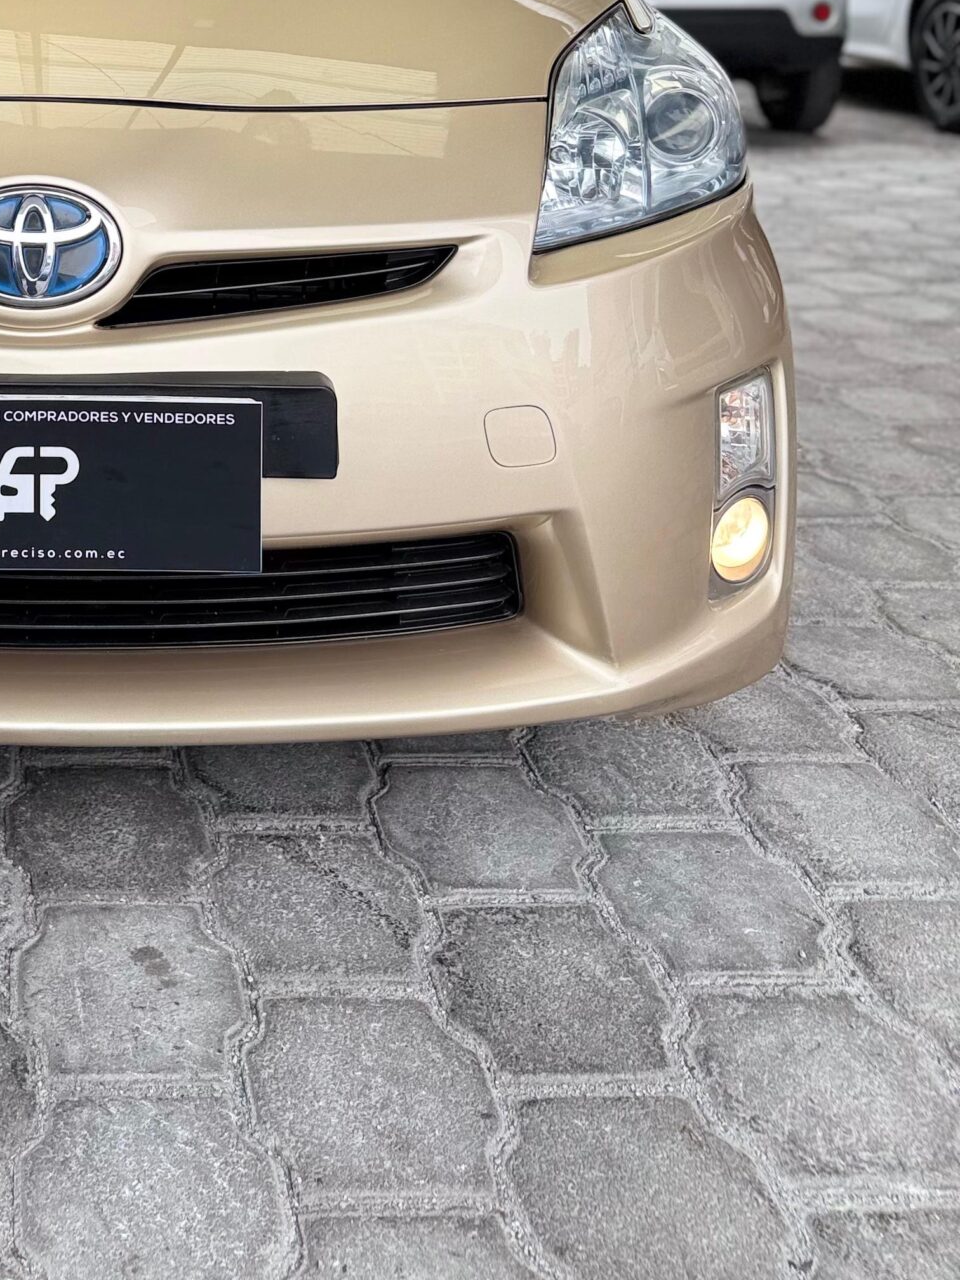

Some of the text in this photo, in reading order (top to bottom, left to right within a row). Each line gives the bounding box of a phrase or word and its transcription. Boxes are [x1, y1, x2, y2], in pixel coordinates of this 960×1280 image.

[3, 410, 119, 423] COMPRADORES
[121, 411, 132, 423] Y
[133, 412, 236, 425] VENDEDORES
